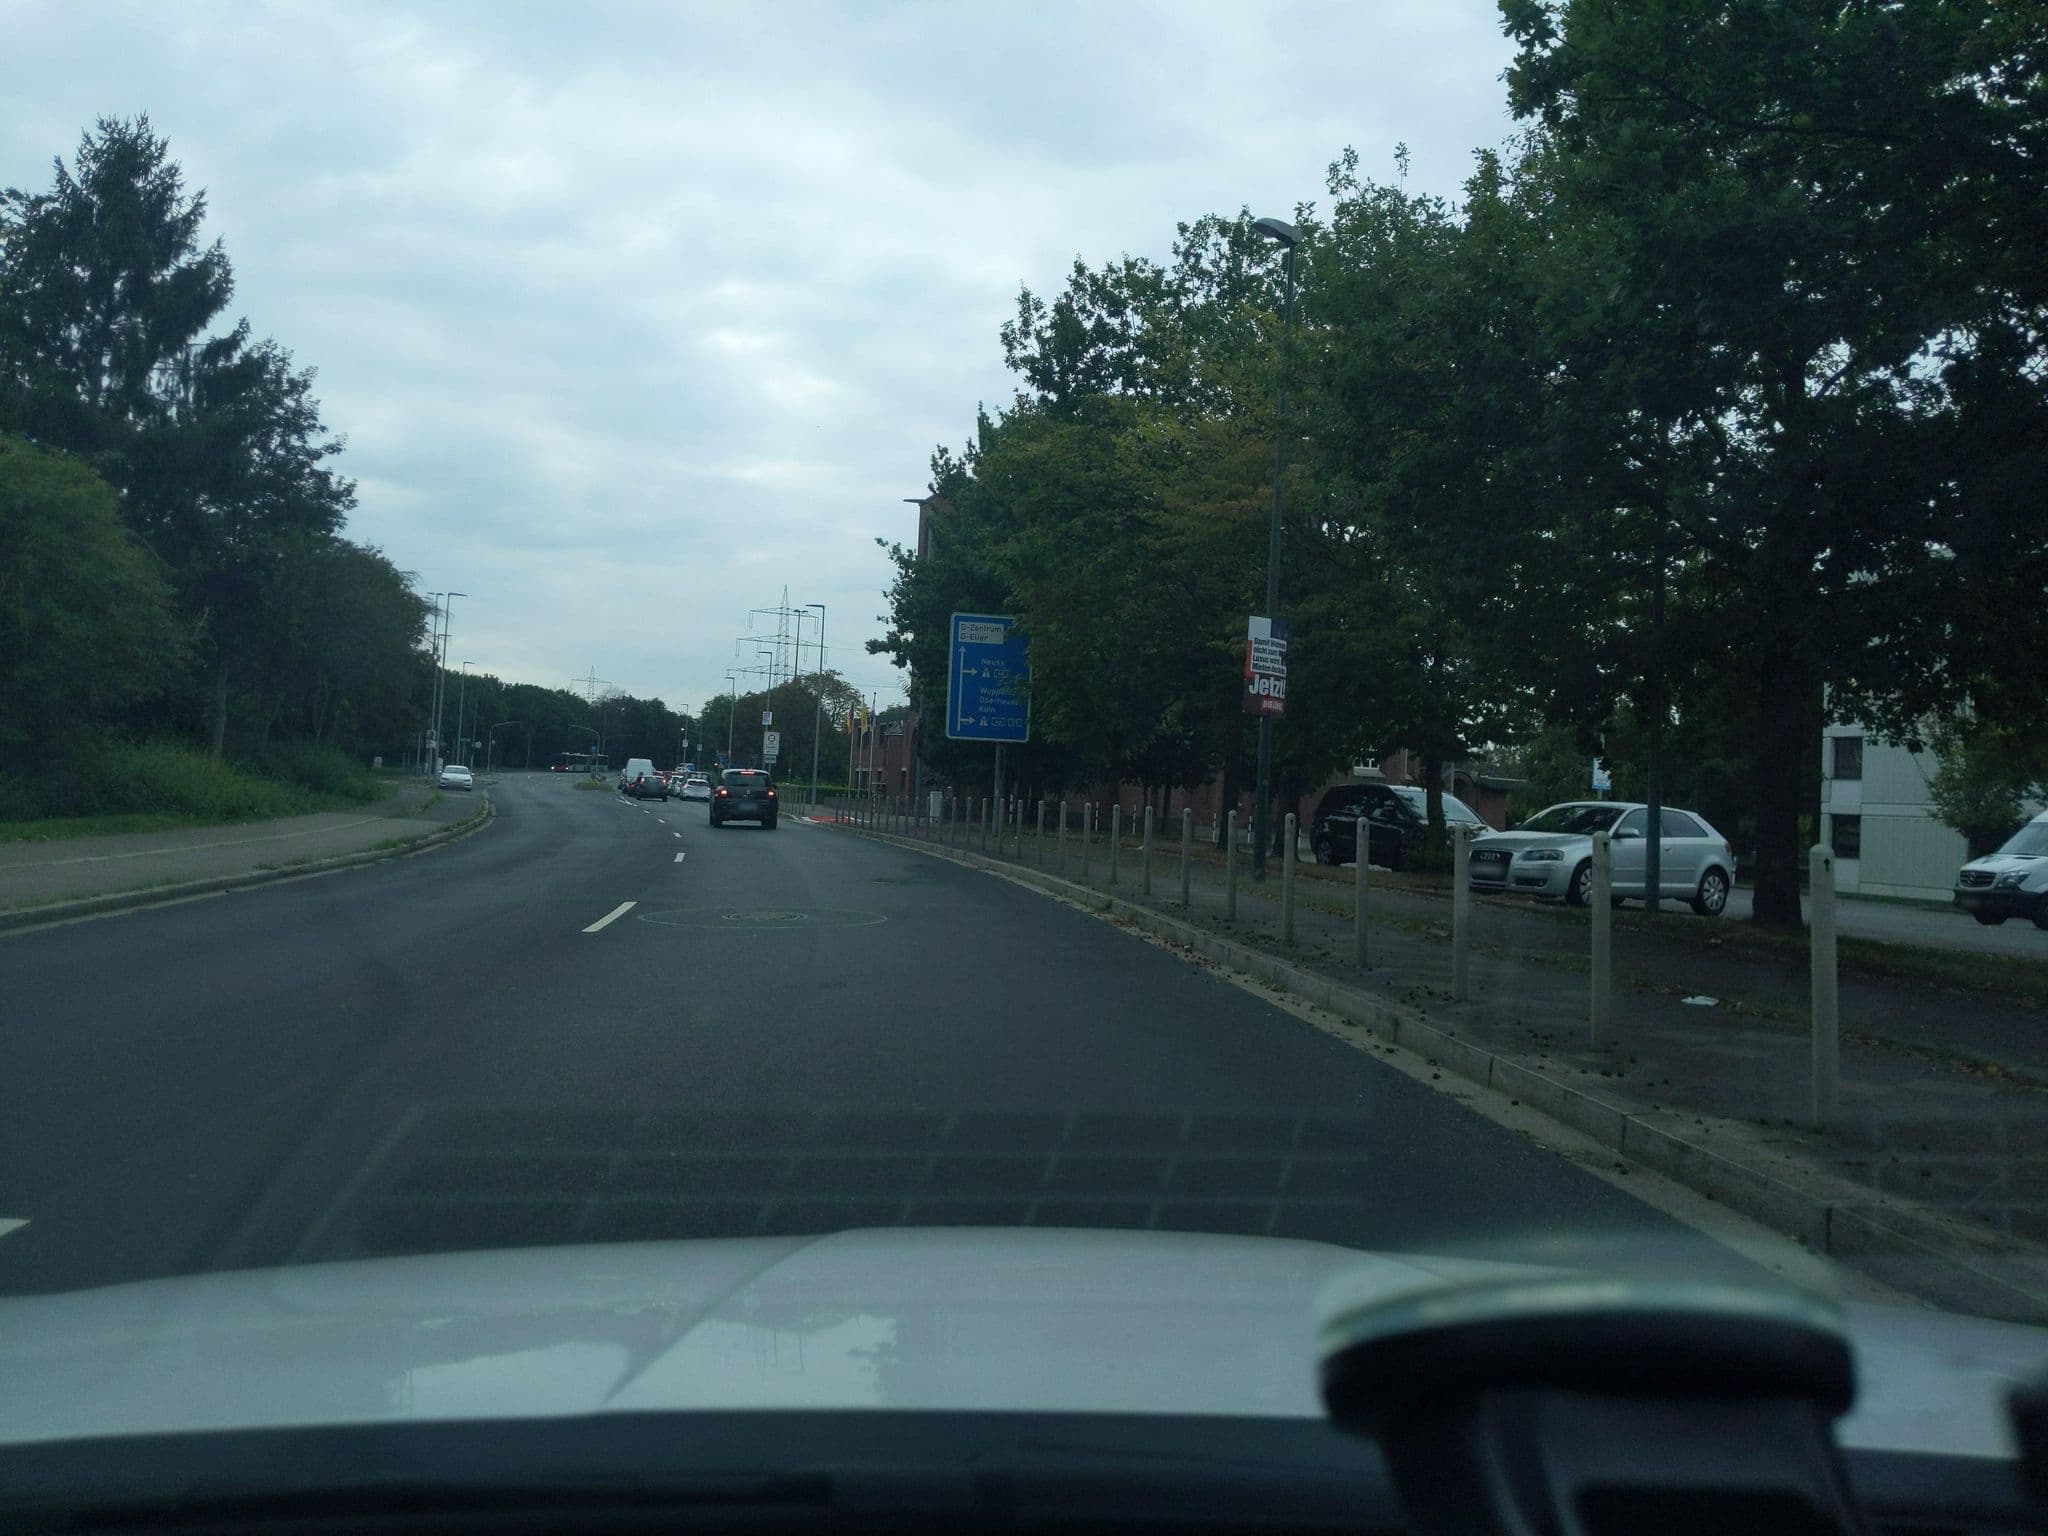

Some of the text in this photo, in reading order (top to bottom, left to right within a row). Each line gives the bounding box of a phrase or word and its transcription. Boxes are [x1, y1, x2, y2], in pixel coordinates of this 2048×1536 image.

[960, 623, 1002, 633] D-Zentrum
[1249, 674, 1286, 700] Jetzt!
[978, 704, 996, 713] Köln
